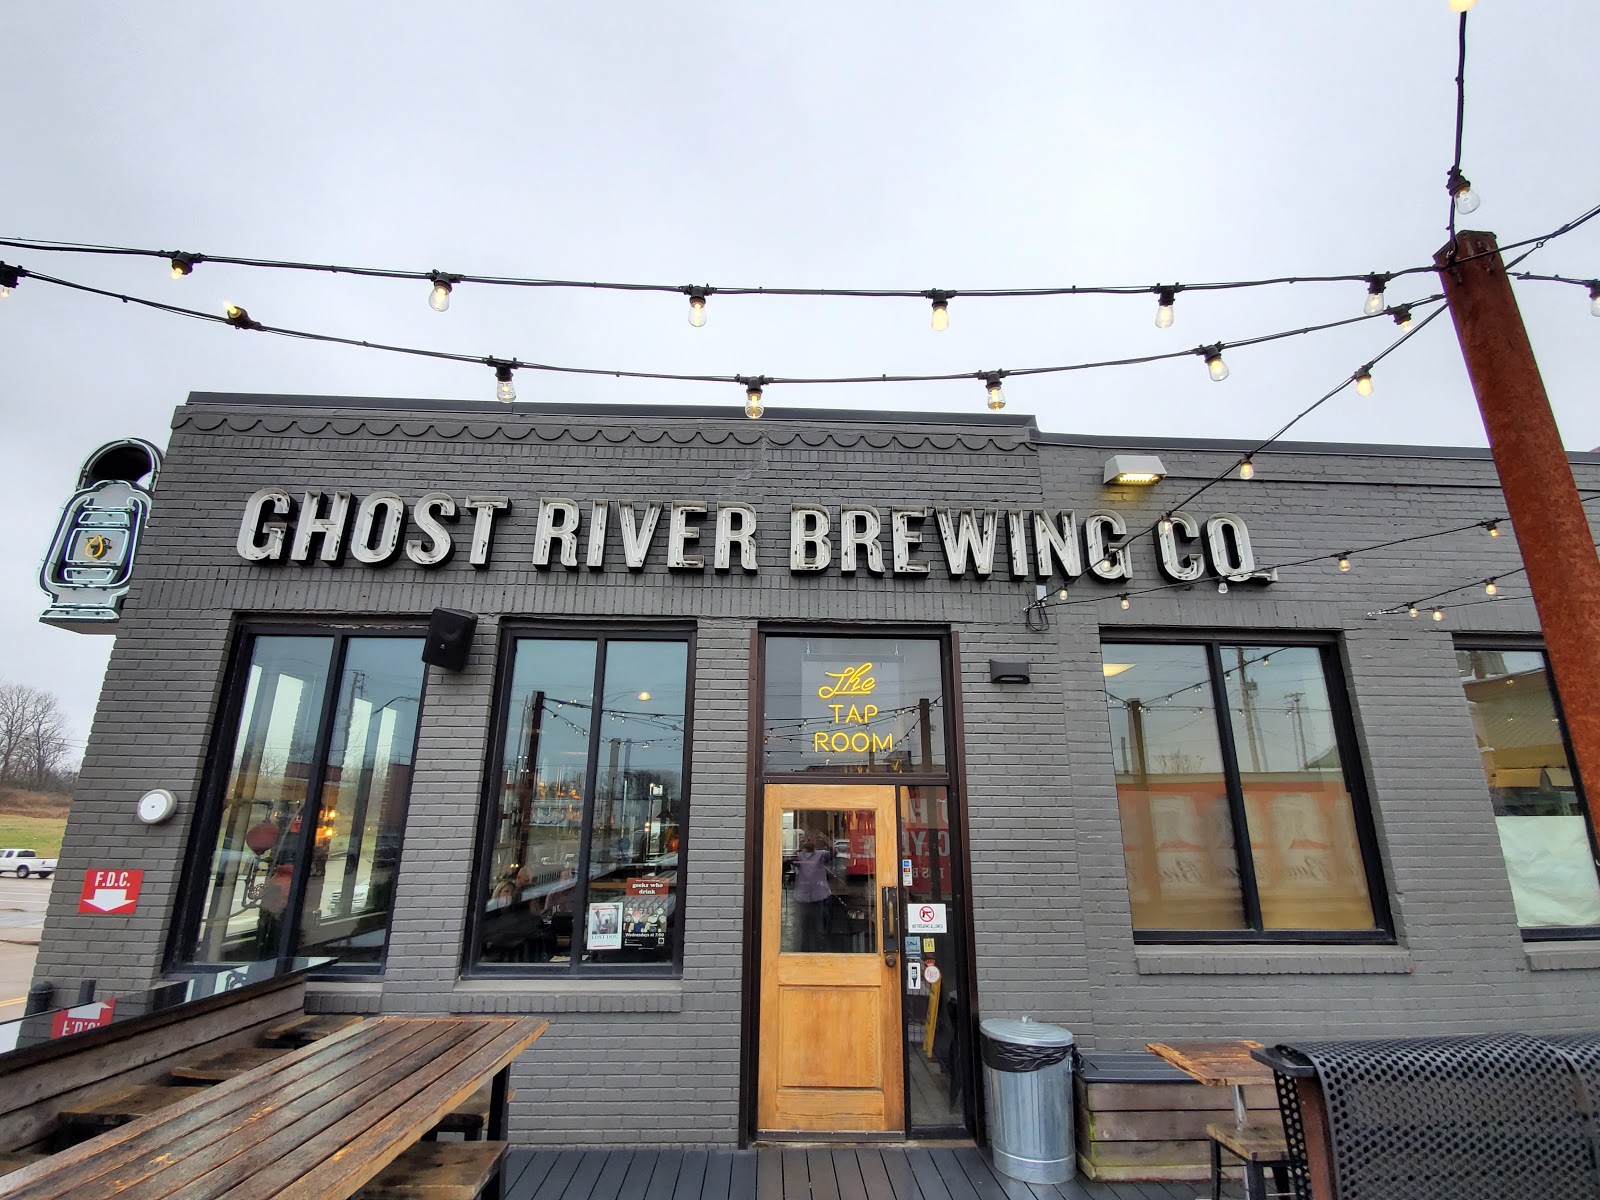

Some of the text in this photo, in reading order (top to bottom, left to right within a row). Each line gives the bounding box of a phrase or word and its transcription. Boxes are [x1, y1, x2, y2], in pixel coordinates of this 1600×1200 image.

[236, 487, 510, 569] GHOST
[532, 497, 758, 574] RIVER
[790, 503, 1132, 582] BREWING
[818, 662, 876, 699] The
[828, 704, 878, 724] TAP
[814, 732, 893, 753] ROOM
[94, 871, 131, 887] F.D.C.
